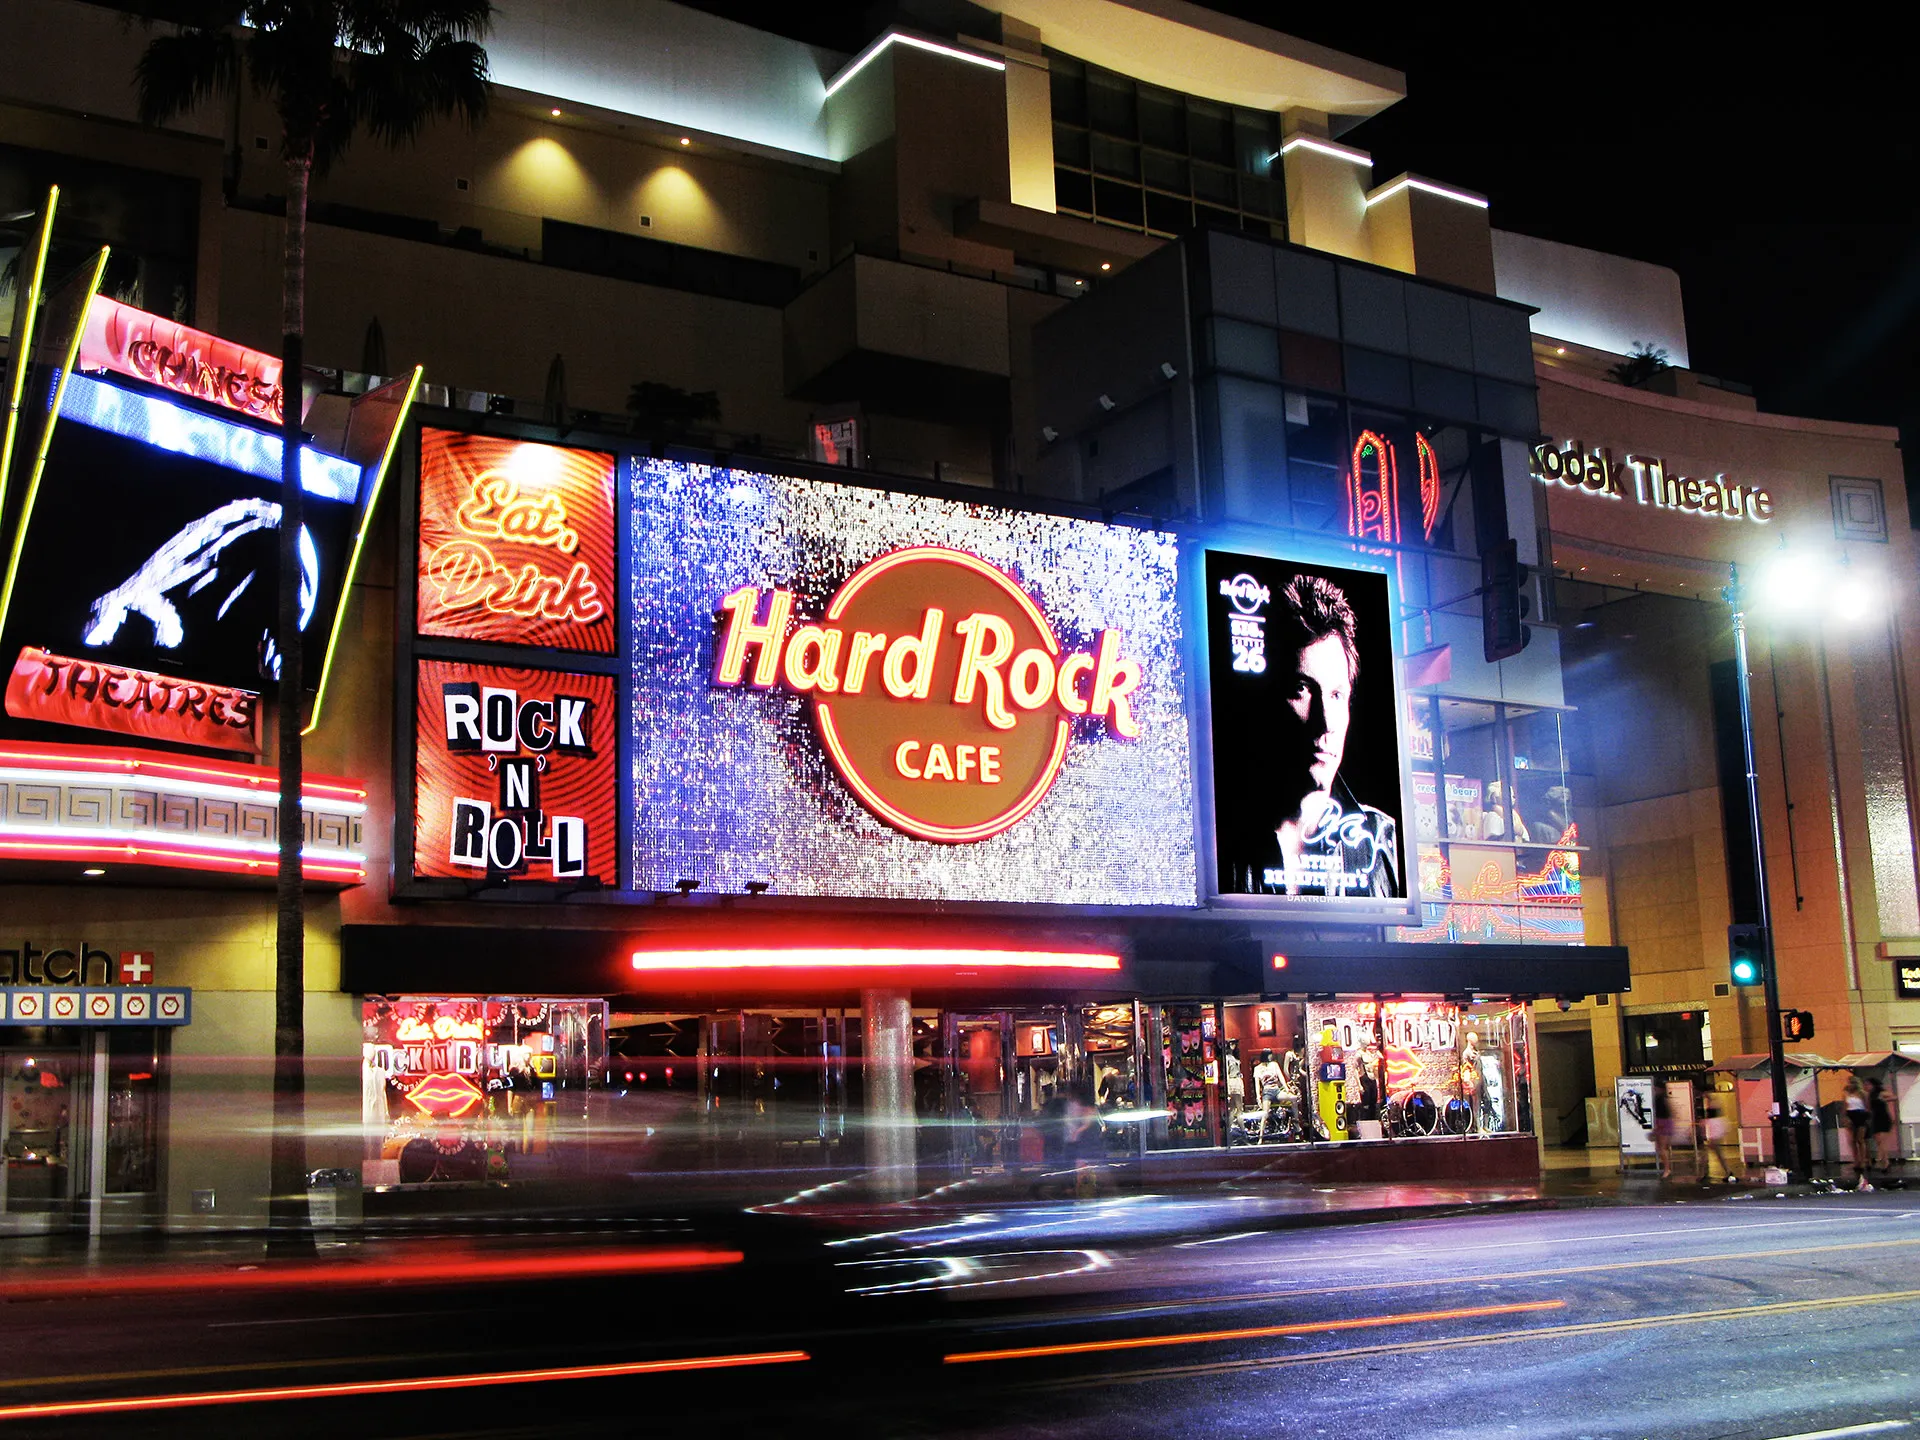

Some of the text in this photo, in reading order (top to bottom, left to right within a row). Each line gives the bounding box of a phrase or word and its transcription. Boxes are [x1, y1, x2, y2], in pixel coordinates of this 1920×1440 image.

[1627, 454, 1774, 524] Theatre
[427, 539, 603, 623] Drink
[42, 657, 257, 729] THEATRES
[717, 587, 1142, 740] Hard Rock
[443, 687, 590, 752] ROCK
[895, 740, 1002, 784] CAFE
[1452, 783, 1479, 797] bears
[450, 798, 585, 877] ROLL
